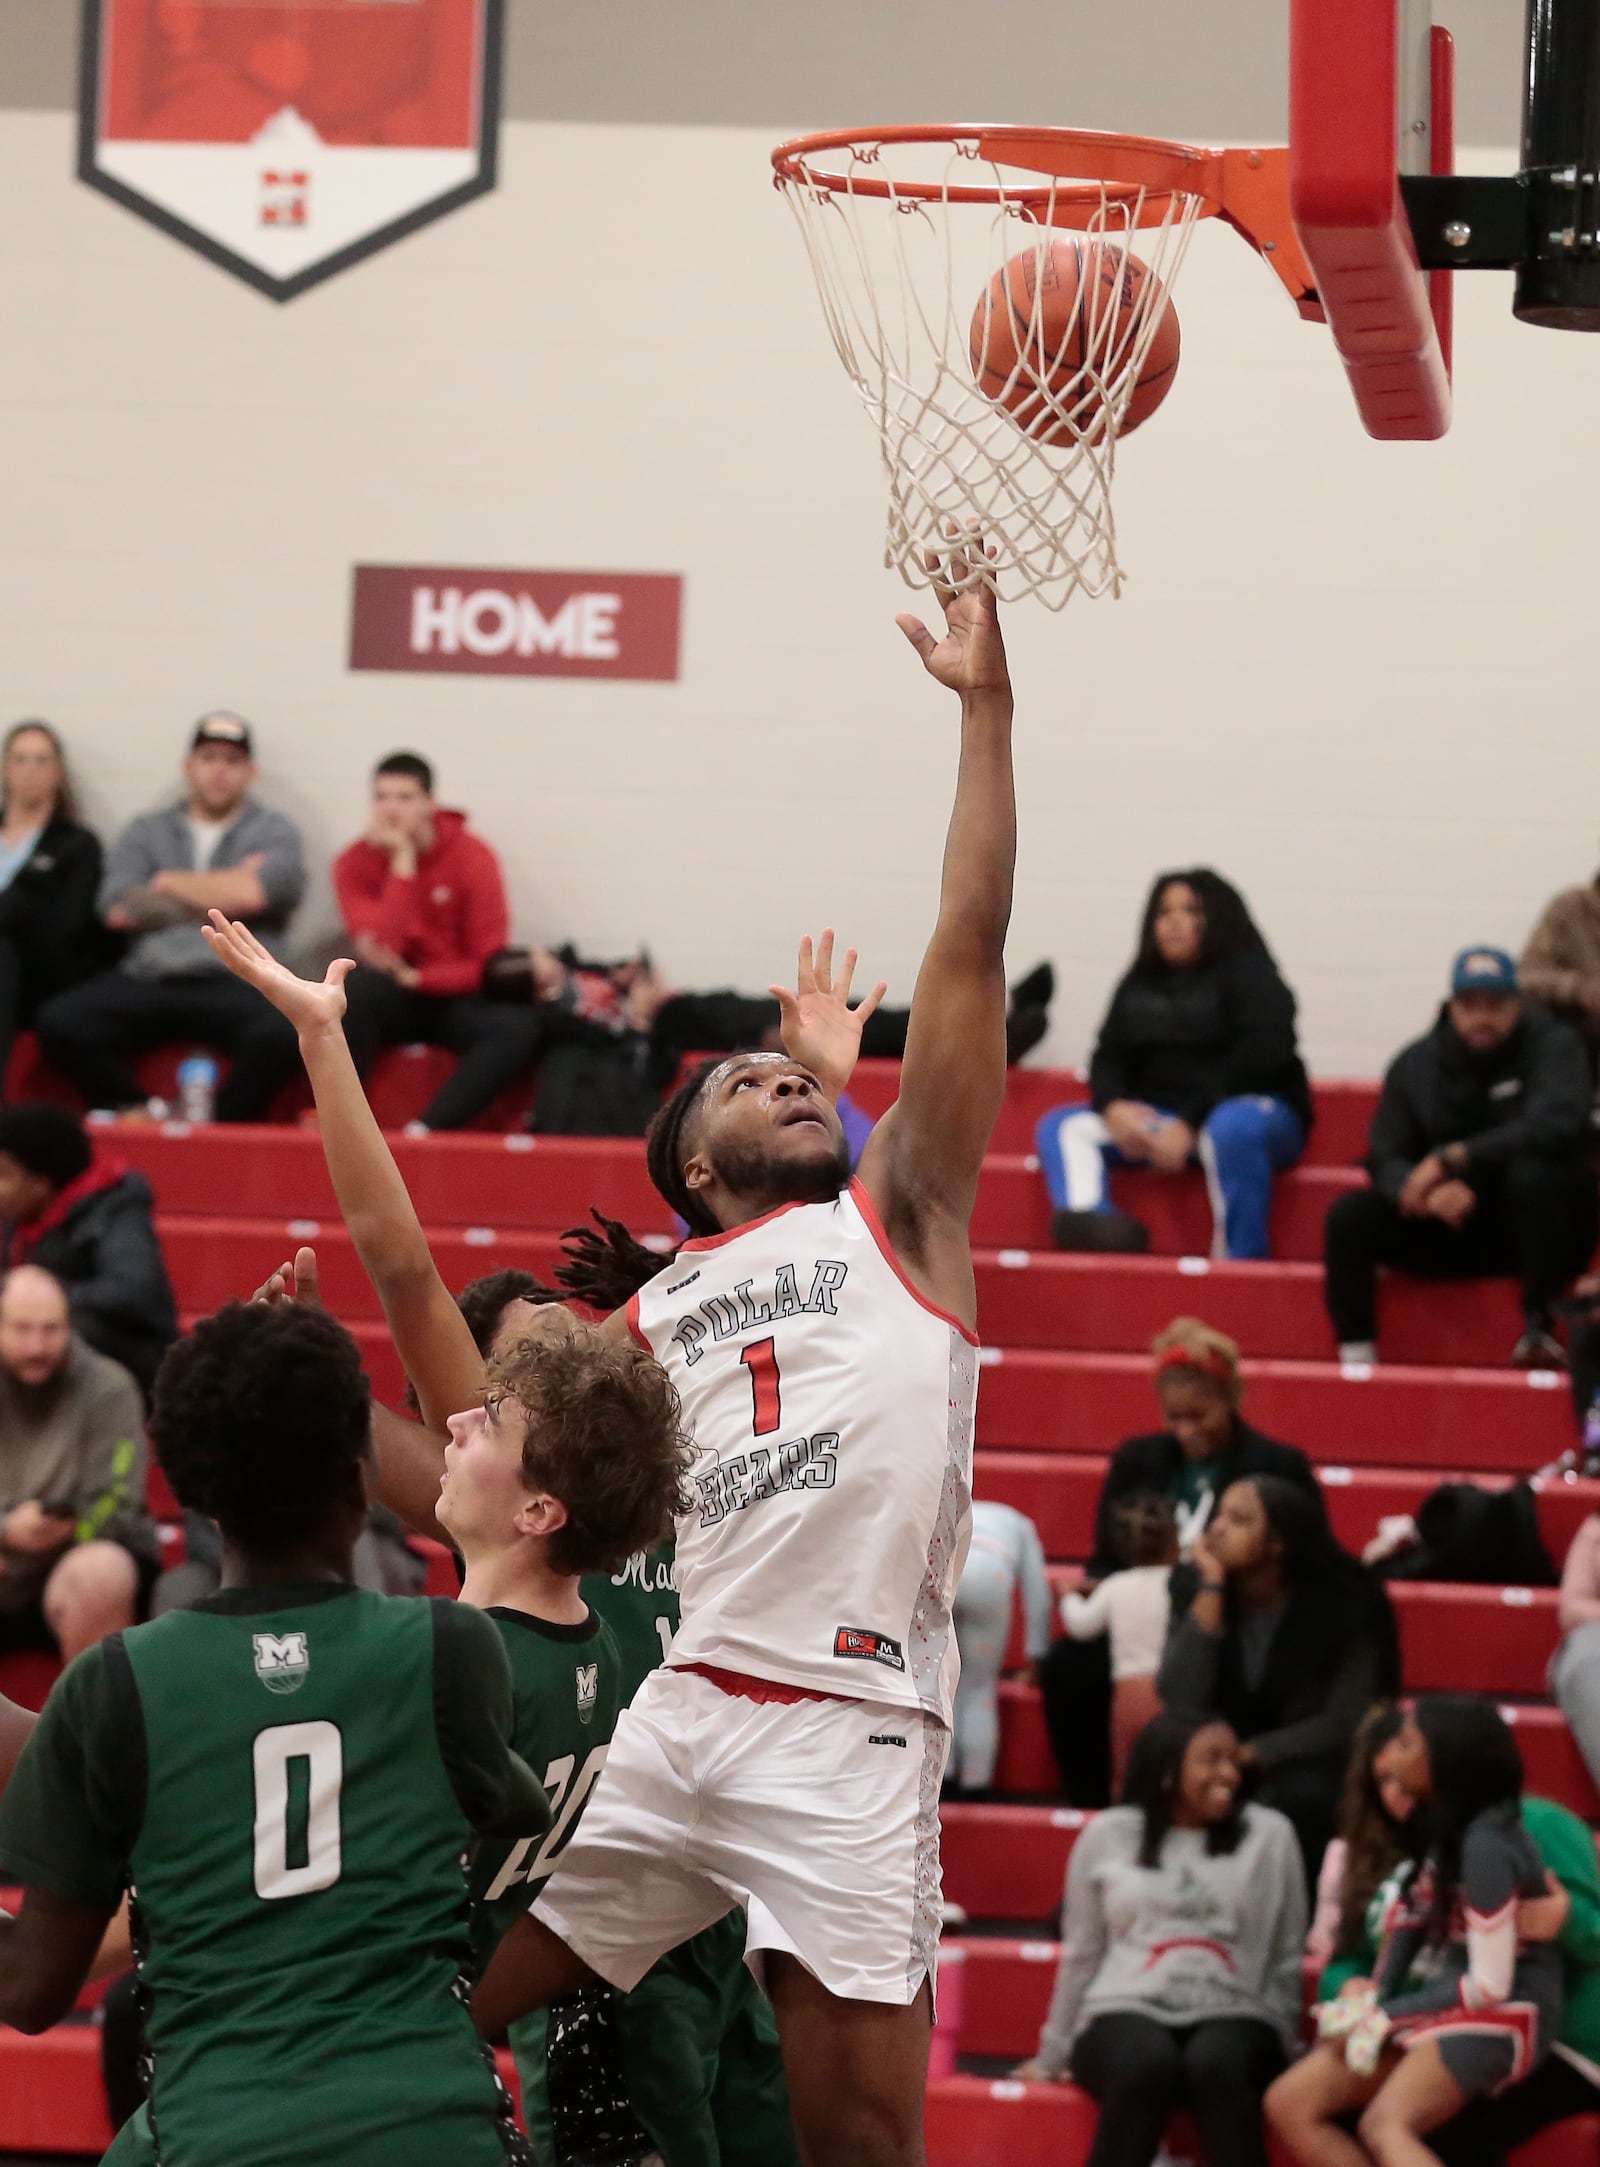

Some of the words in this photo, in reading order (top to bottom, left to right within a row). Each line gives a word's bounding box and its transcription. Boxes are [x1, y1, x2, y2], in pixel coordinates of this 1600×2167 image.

[409, 586, 622, 660] HOME
[671, 1259, 849, 1368] POLAR
[739, 1335, 782, 1438] 1
[695, 1431, 841, 1529] BEARS
[252, 1631, 309, 1675] M
[575, 1663, 598, 1705] M
[252, 1719, 344, 1900] 0
